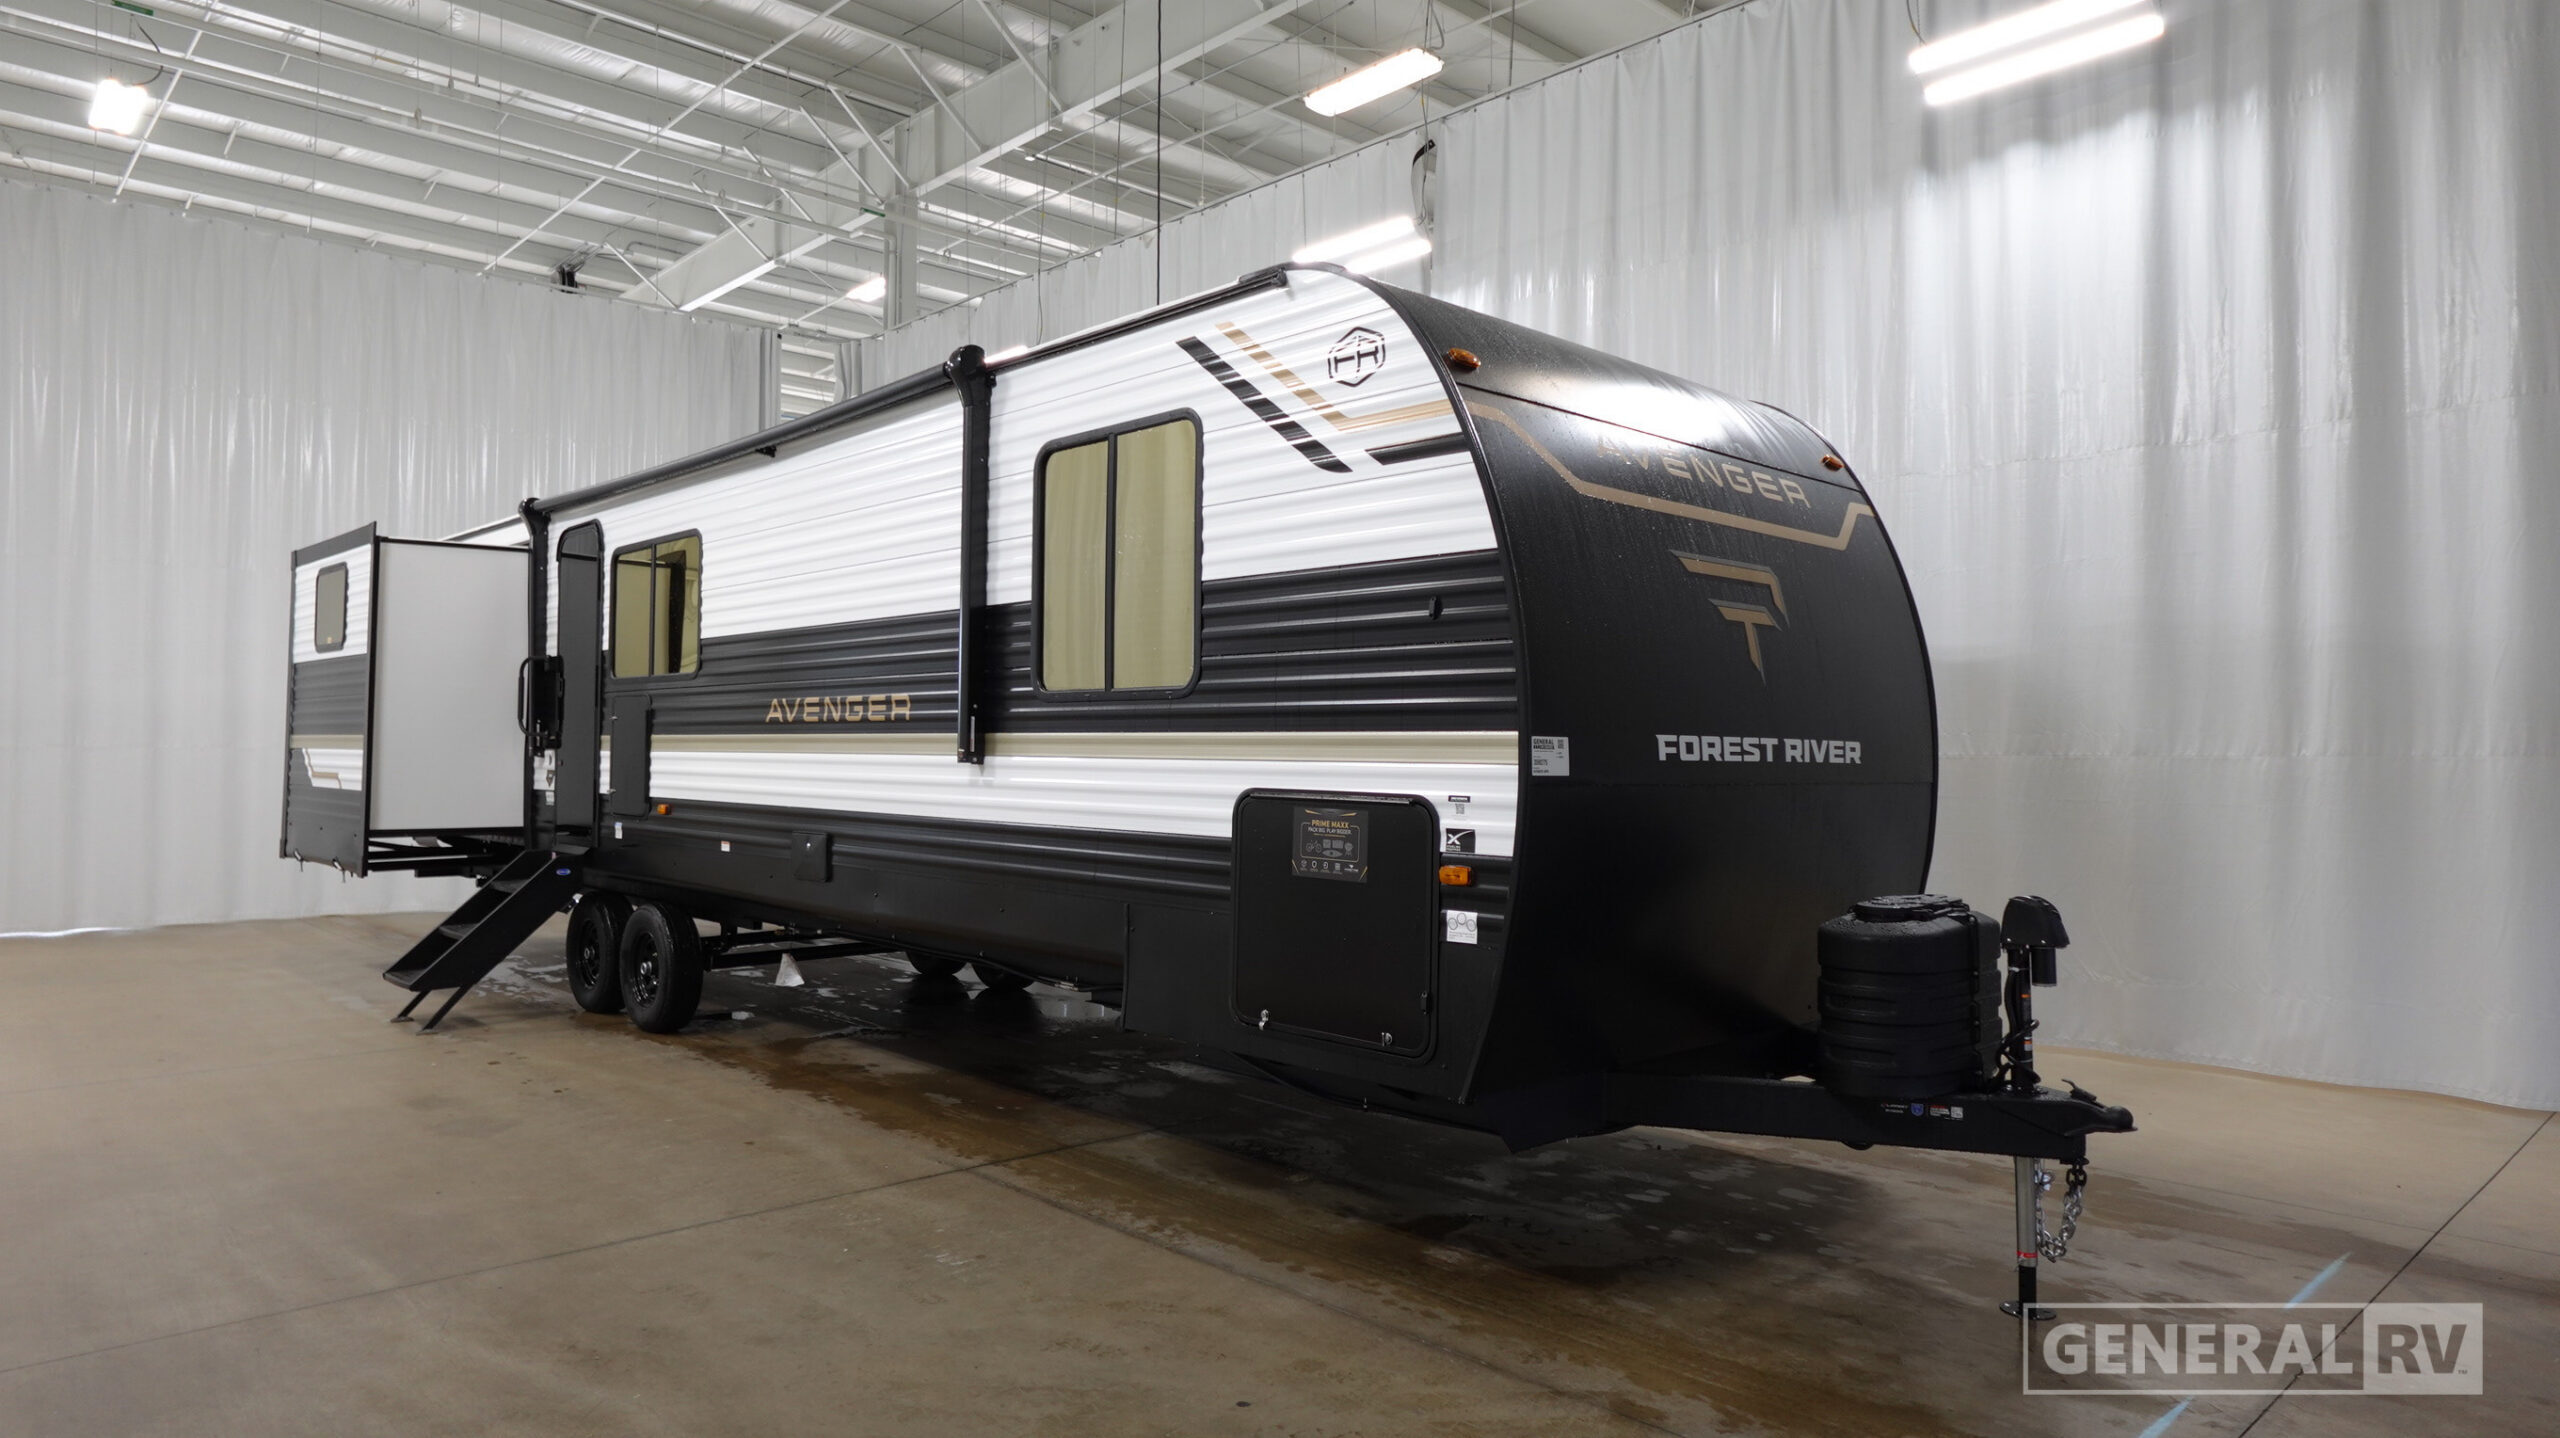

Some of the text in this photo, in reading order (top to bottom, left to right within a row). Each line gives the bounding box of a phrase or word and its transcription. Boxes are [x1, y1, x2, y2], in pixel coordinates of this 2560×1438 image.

[1596, 440, 1811, 508] AVENGER
[765, 693, 912, 723] AVENGER
[1656, 734, 1862, 764] FOREST RIVER
[1311, 819, 1350, 829] PRIME MAXX
